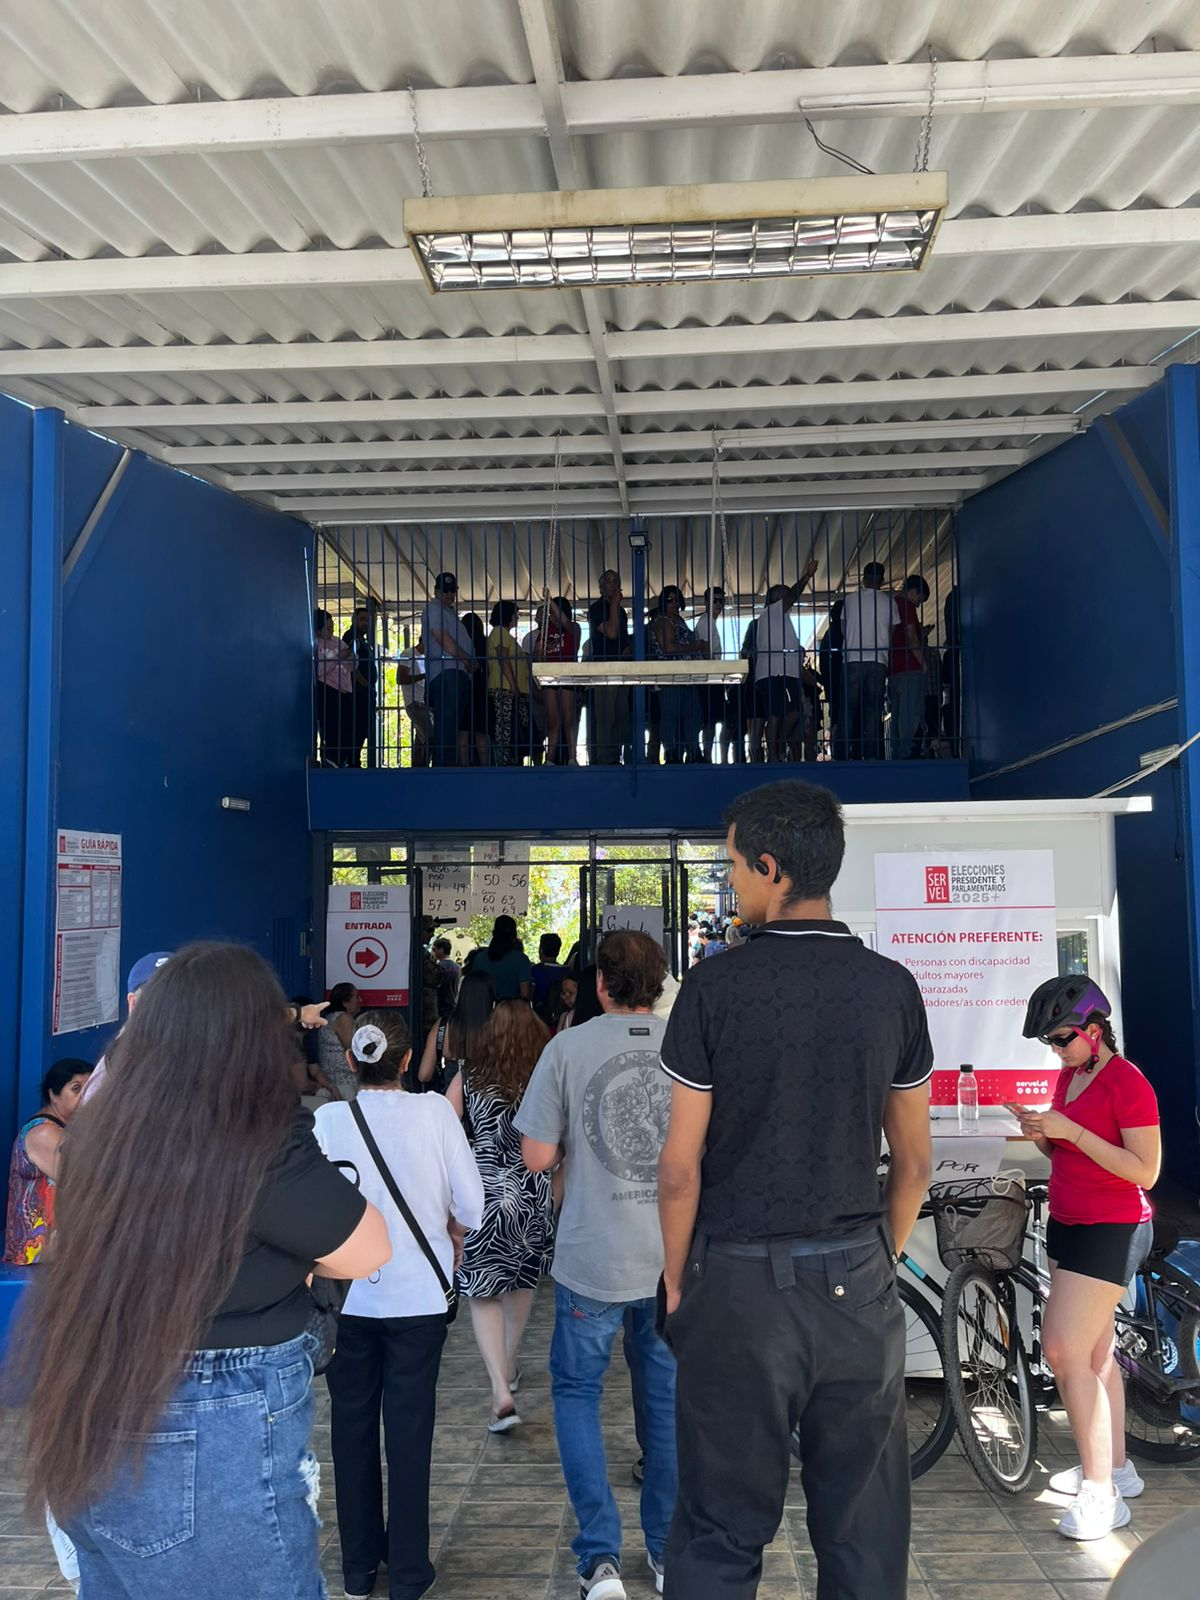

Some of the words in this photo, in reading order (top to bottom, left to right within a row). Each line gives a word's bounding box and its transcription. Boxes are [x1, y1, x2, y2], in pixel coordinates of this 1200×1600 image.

[81, 837, 97, 849] GUÍA
[97, 838, 118, 851] RÁPIDA
[951, 865, 1005, 876] ELECCIONES
[484, 874, 500, 886] 50
[509, 874, 527, 887] 56
[928, 873, 946, 886] SER
[951, 876, 997, 884] PRESIDENTE
[428, 883, 441, 892] 44
[453, 883, 466, 894] 49
[928, 887, 948, 900] VEL
[952, 884, 1006, 892] PARLAMENTARIOS
[428, 899, 442, 911] 57
[454, 899, 467, 912] 59
[482, 895, 495, 904] 60
[501, 895, 516, 905] 63
[344, 922, 392, 930] ENTRADA
[891, 931, 956, 944] ATENCIÓN
[959, 931, 1043, 943] PREFERENTE:
[905, 958, 947, 967] Personas
[949, 959, 967, 967] con
[968, 957, 1031, 968] discapacidad
[913, 972, 942, 980] dultos
[944, 971, 984, 982] mayores
[920, 985, 969, 994] barazadas
[923, 998, 974, 1007] dadores/as
[975, 999, 993, 1007] con
[995, 997, 1028, 1006] creden
[935, 1159, 980, 1173] POR
